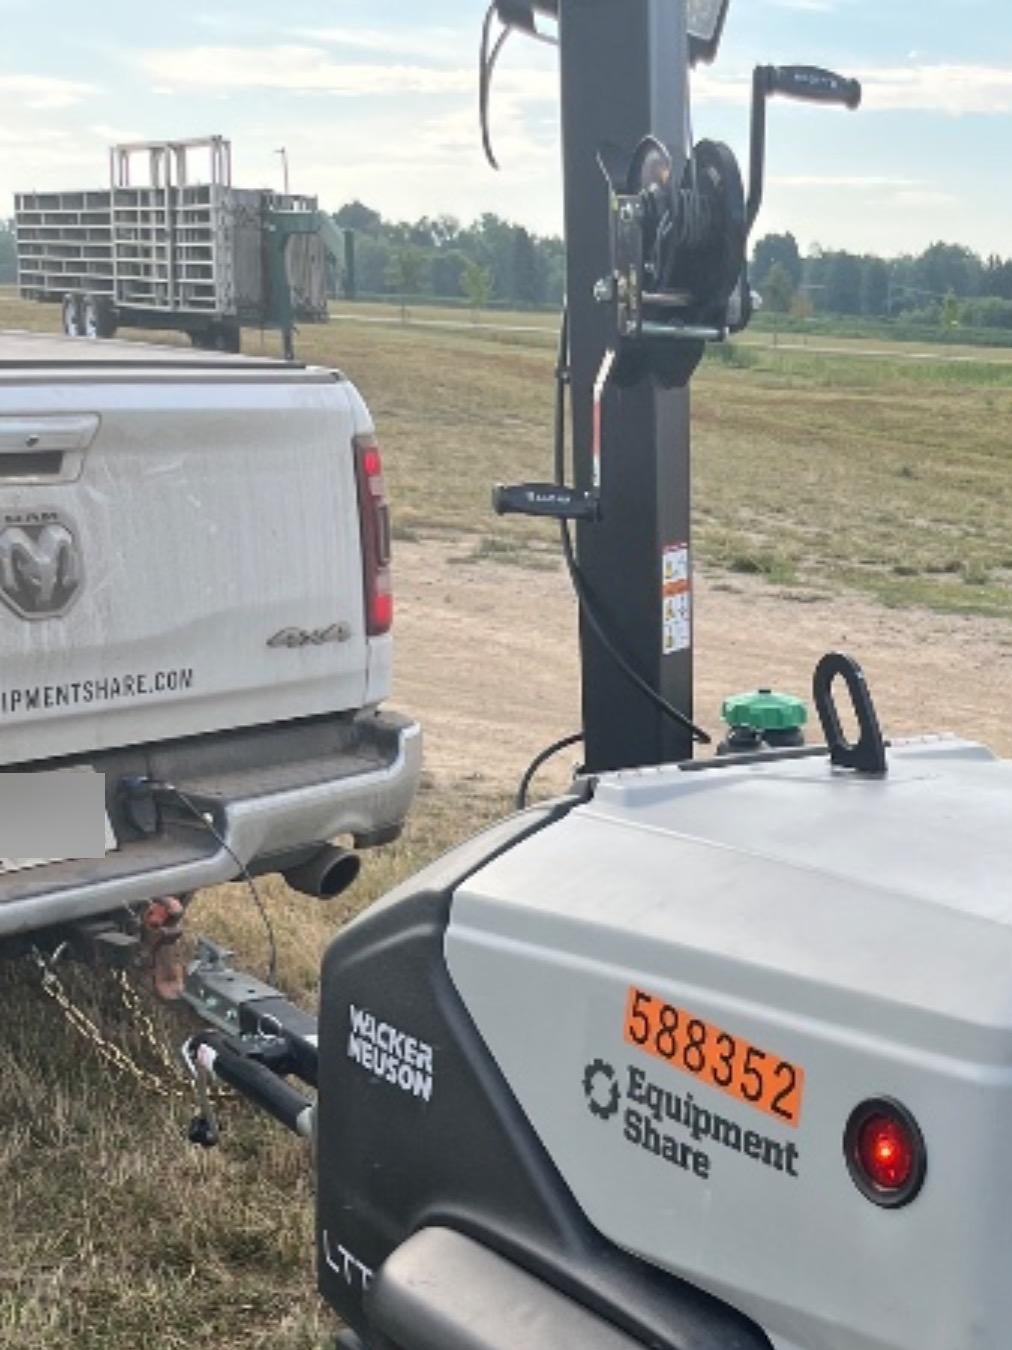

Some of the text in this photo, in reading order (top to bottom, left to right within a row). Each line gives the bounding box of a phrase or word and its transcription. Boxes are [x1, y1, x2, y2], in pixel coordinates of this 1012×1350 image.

[346, 1030, 433, 1102] NEUSON
[349, 1003, 433, 1075] WACKER
[629, 989, 797, 1121] 588352
[623, 1107, 711, 1180] Share
[626, 1064, 799, 1177] Equipment
